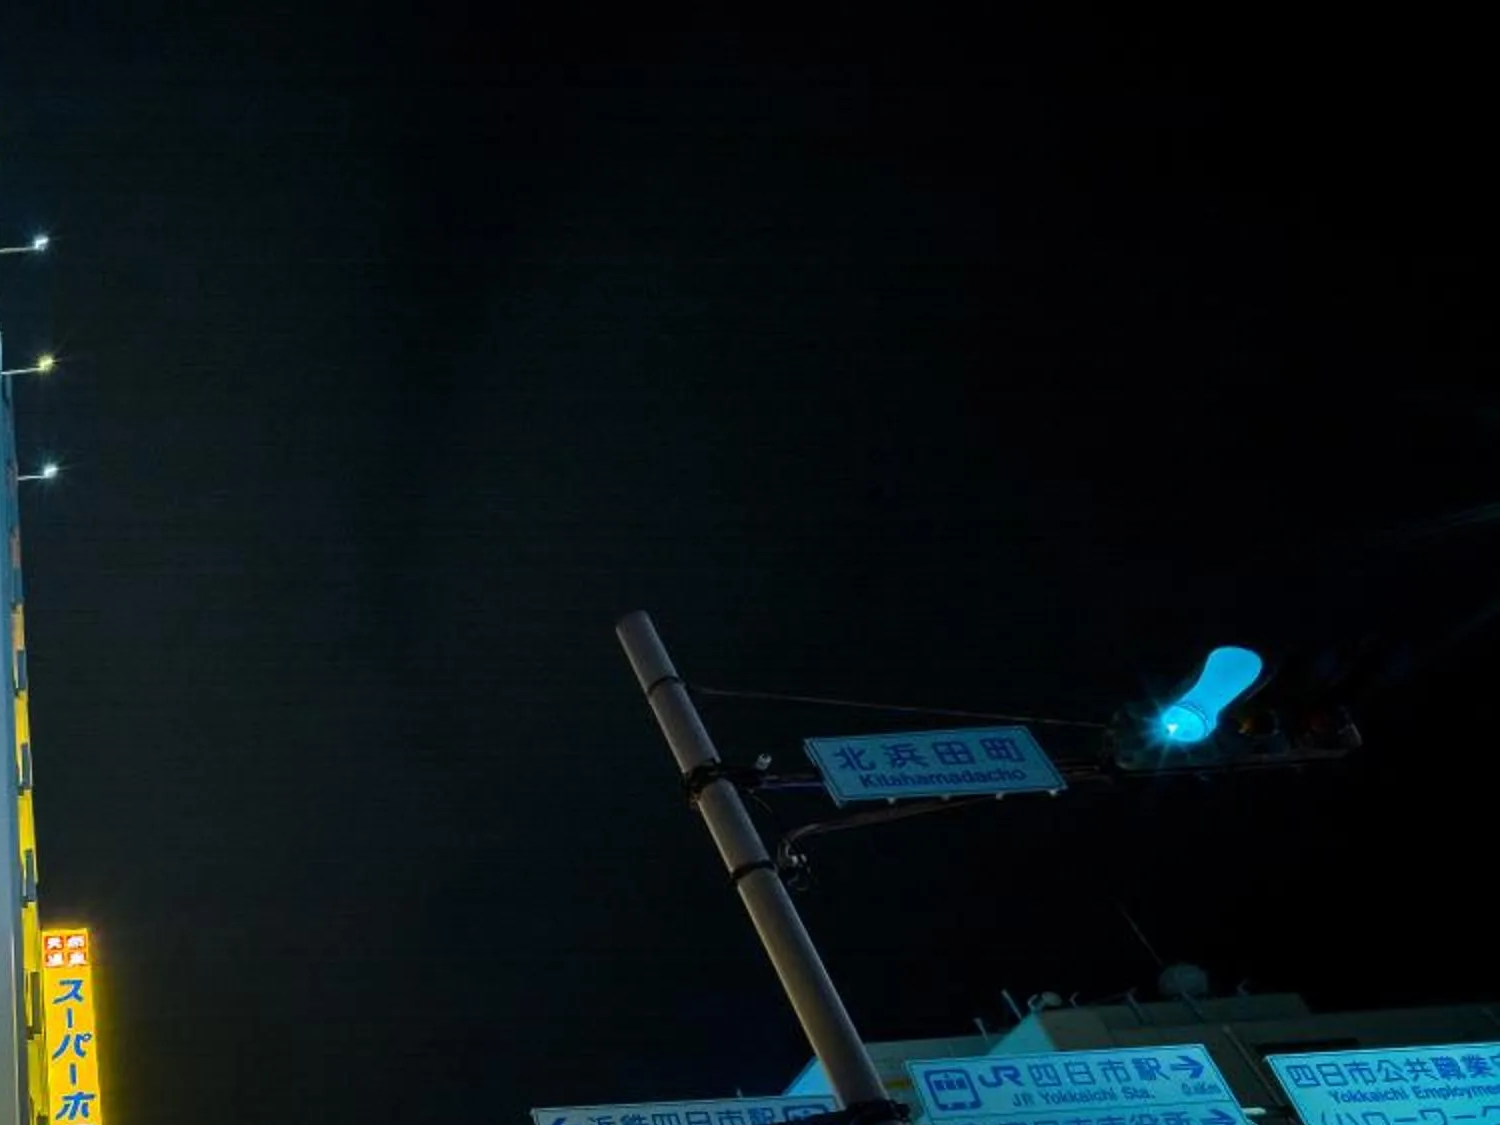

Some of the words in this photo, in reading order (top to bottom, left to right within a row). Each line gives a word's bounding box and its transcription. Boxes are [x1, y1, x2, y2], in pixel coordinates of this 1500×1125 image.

[832, 736, 1026, 772] 北浜田町
[859, 767, 1027, 789] Kitahamadacho
[1012, 1093, 1034, 1108] JR
[1041, 1086, 1115, 1105] Yokkaichi
[1327, 1087, 1410, 1104] Yokkaichi
